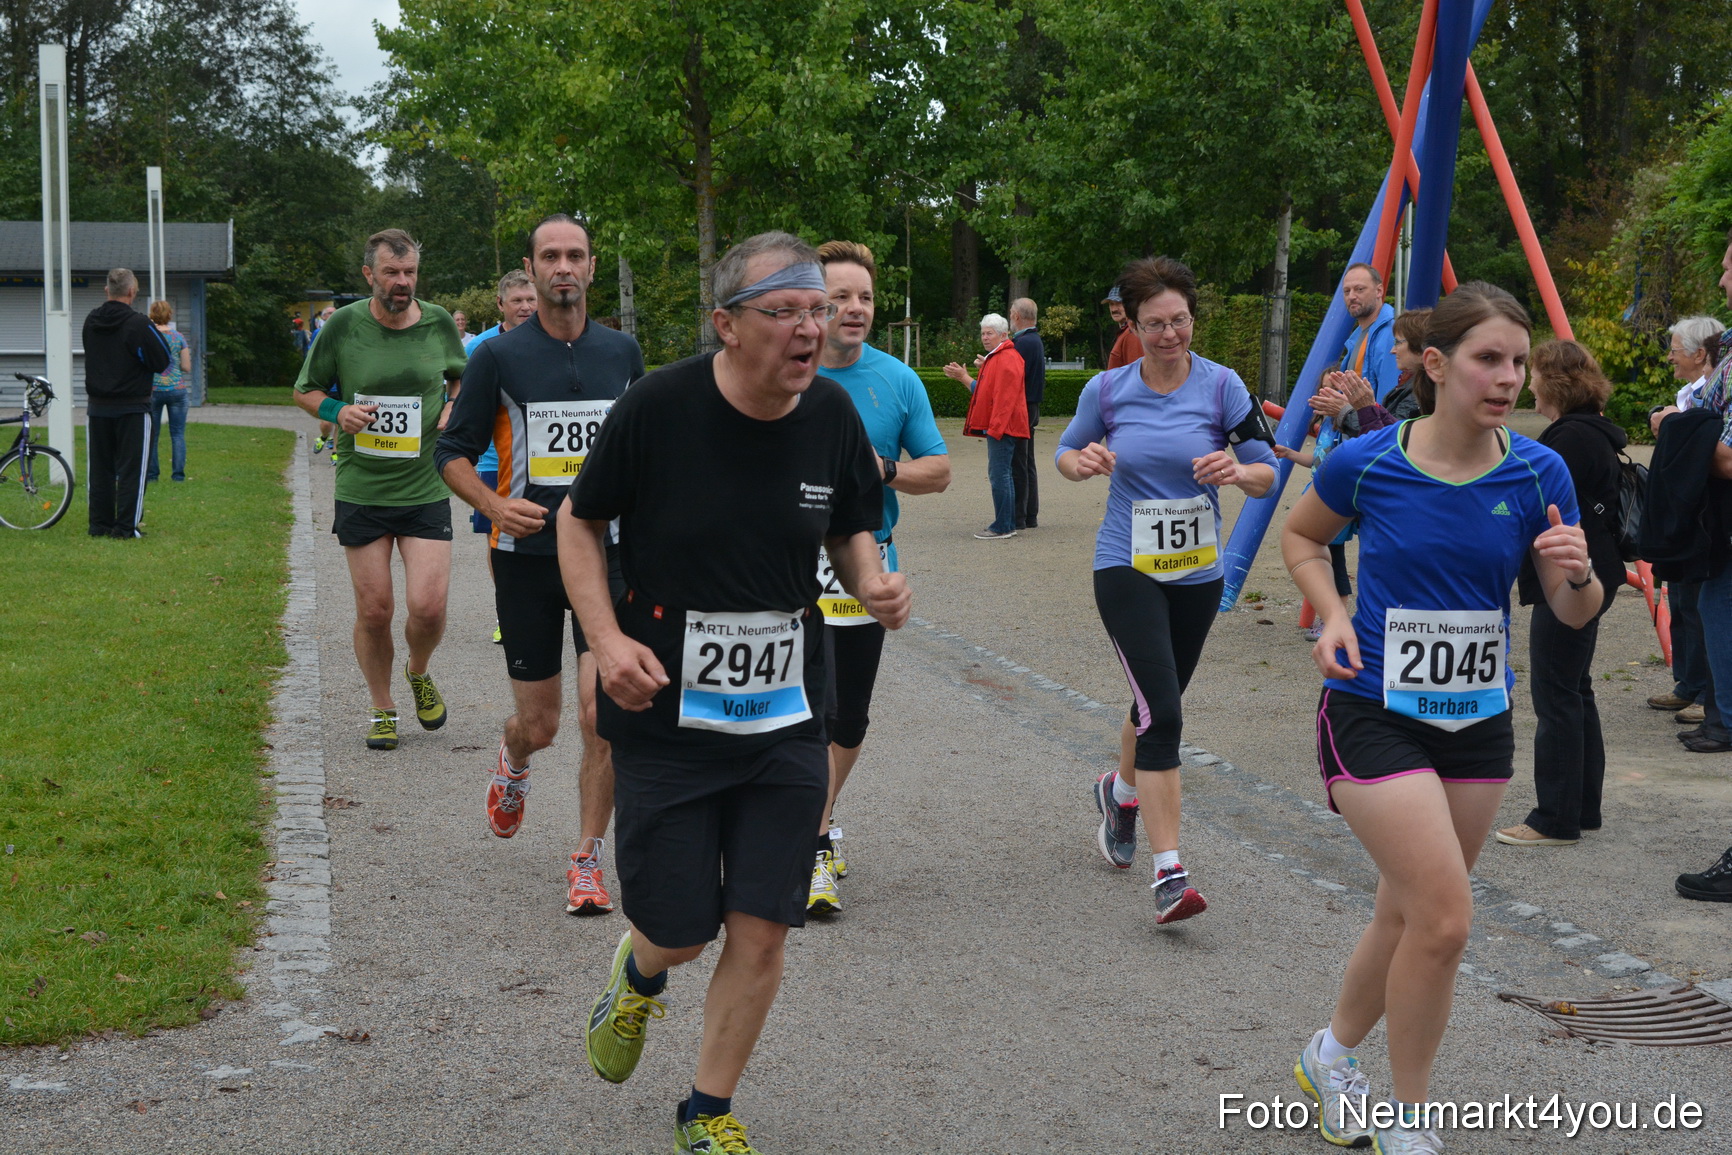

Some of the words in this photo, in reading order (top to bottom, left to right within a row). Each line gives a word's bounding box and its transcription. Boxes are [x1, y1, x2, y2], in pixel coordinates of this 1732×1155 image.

[367, 411, 408, 434] 233
[529, 410, 560, 419] PARTL
[561, 409, 603, 417] Neumarkt
[374, 438, 398, 449] Peter
[1134, 508, 1163, 516] PARTL
[1164, 504, 1203, 516] Neumarkt
[1150, 516, 1200, 550] 151
[1154, 555, 1199, 571] Katarina
[689, 622, 734, 636] PARTL
[737, 622, 789, 636] Neumarkt
[1388, 621, 1435, 634] PARTL
[1438, 623, 1496, 635] Neumarkt
[696, 638, 795, 688] 2947
[1398, 640, 1500, 686] 2045
[722, 698, 771, 718] Volker
[1417, 696, 1478, 715] Barbara
